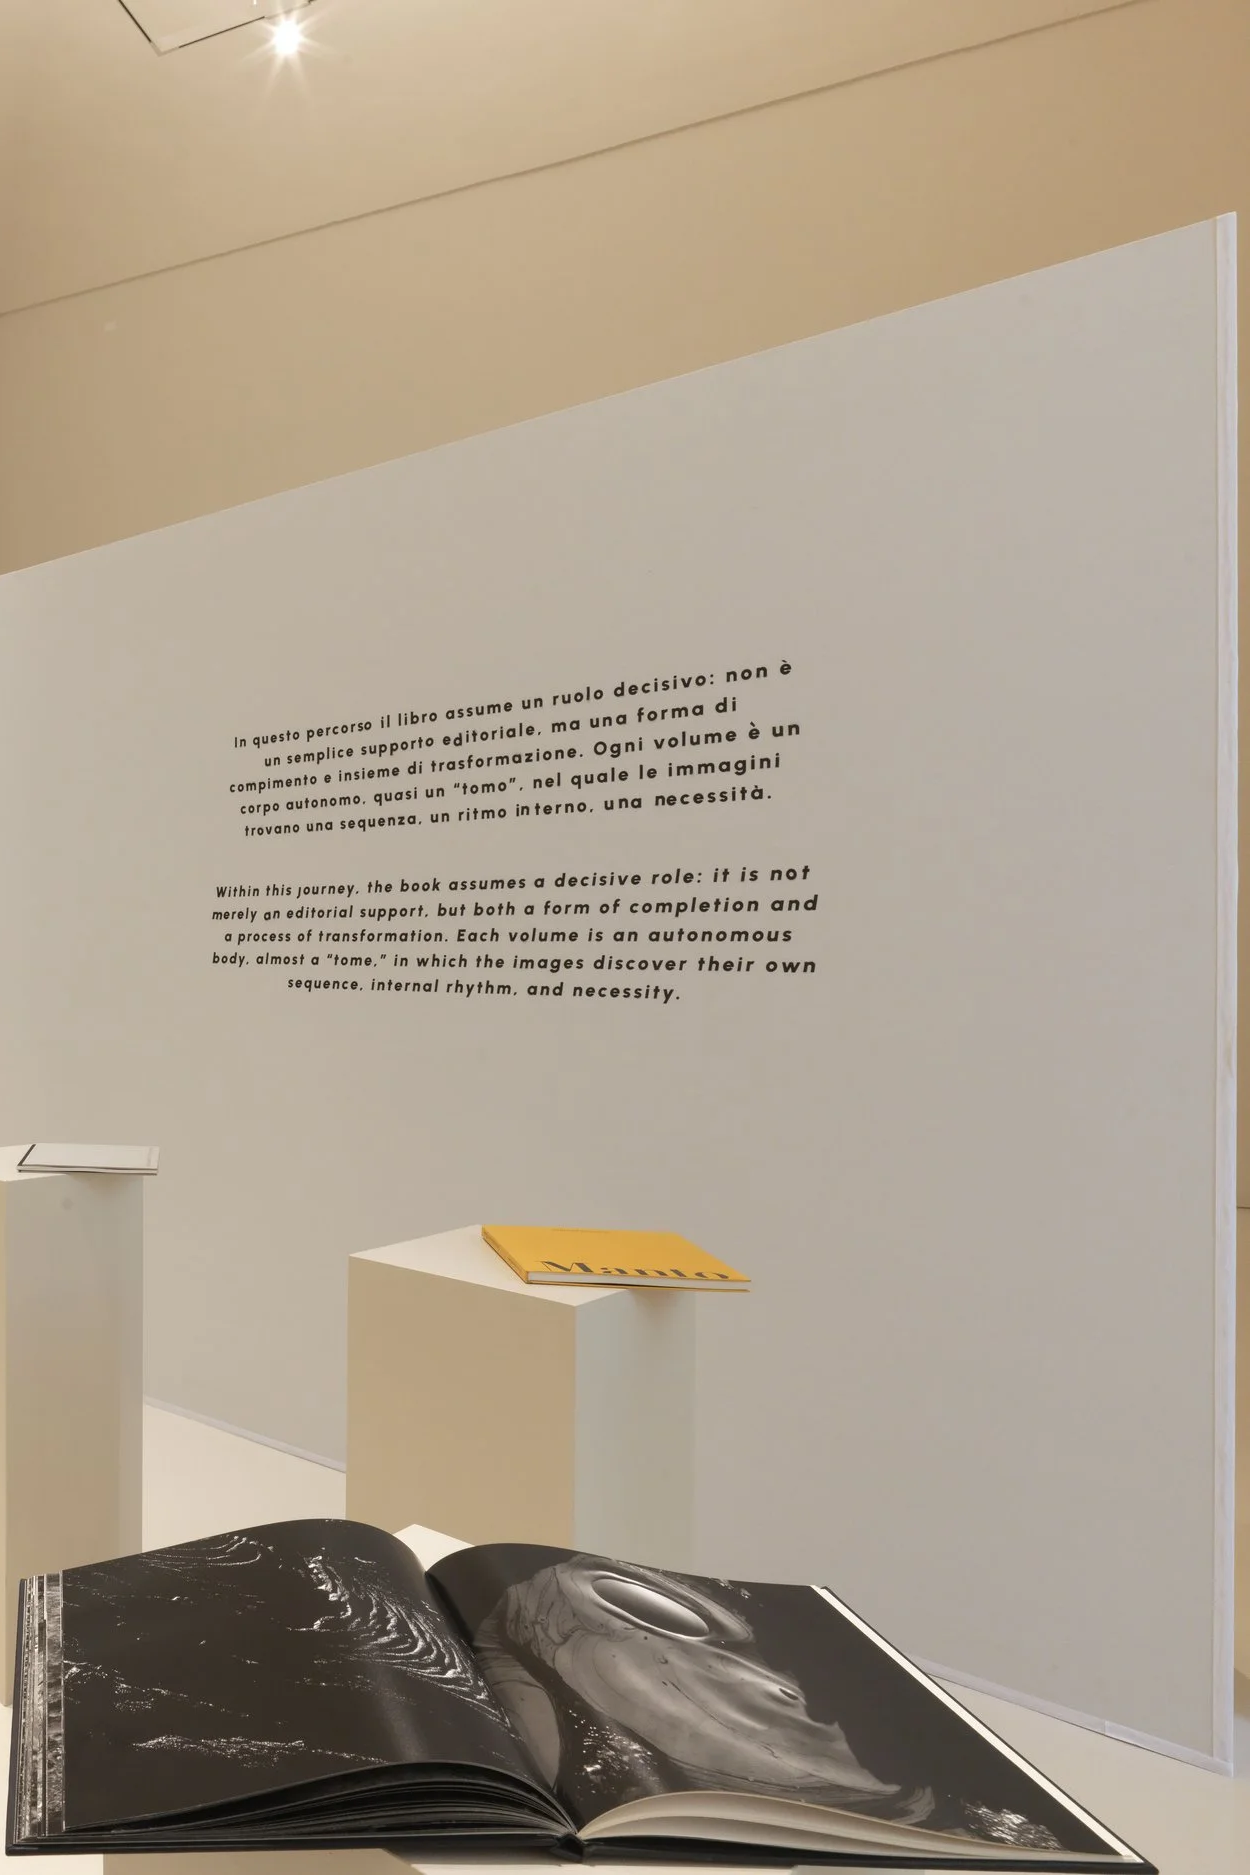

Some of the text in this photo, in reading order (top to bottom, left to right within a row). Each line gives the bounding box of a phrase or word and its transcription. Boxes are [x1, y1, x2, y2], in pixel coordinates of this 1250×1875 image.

[234, 659, 792, 750] In questo percorso il libro assume un ruolo decisivo: non è
[264, 696, 737, 768] un semplice supporto editoriale, ma una forma di
[229, 720, 800, 795] compimento e insieme di trasformazione. Ogni volume è un
[239, 802, 280, 817] corpo
[285, 794, 366, 811] autonomo,
[373, 786, 418, 807] quasi
[425, 787, 445, 799] un
[532, 771, 561, 790] nel
[570, 766, 629, 790] quale
[638, 764, 658, 780] le
[667, 752, 780, 778] immagini
[244, 784, 772, 837] trovano una sequenza, un ritmo interno, una necessità.
[215, 864, 811, 900] Within this journey, the book assumes a decisive role: it is not
[211, 893, 819, 924] merely an editorial support, but both a form of completion and
[224, 927, 793, 946] a process of transformation. Each volume is an autonomous
[211, 951, 250, 968] body,
[255, 951, 305, 966] almost
[310, 956, 320, 966] a
[393, 953, 409, 967] in
[416, 953, 468, 968] which
[475, 953, 505, 969] the
[512, 954, 585, 974] images
[593, 954, 688, 972] discover
[697, 955, 755, 973] their
[765, 960, 816, 974] own
[287, 978, 680, 1005] sequence, internal rhythm, and necessity.
